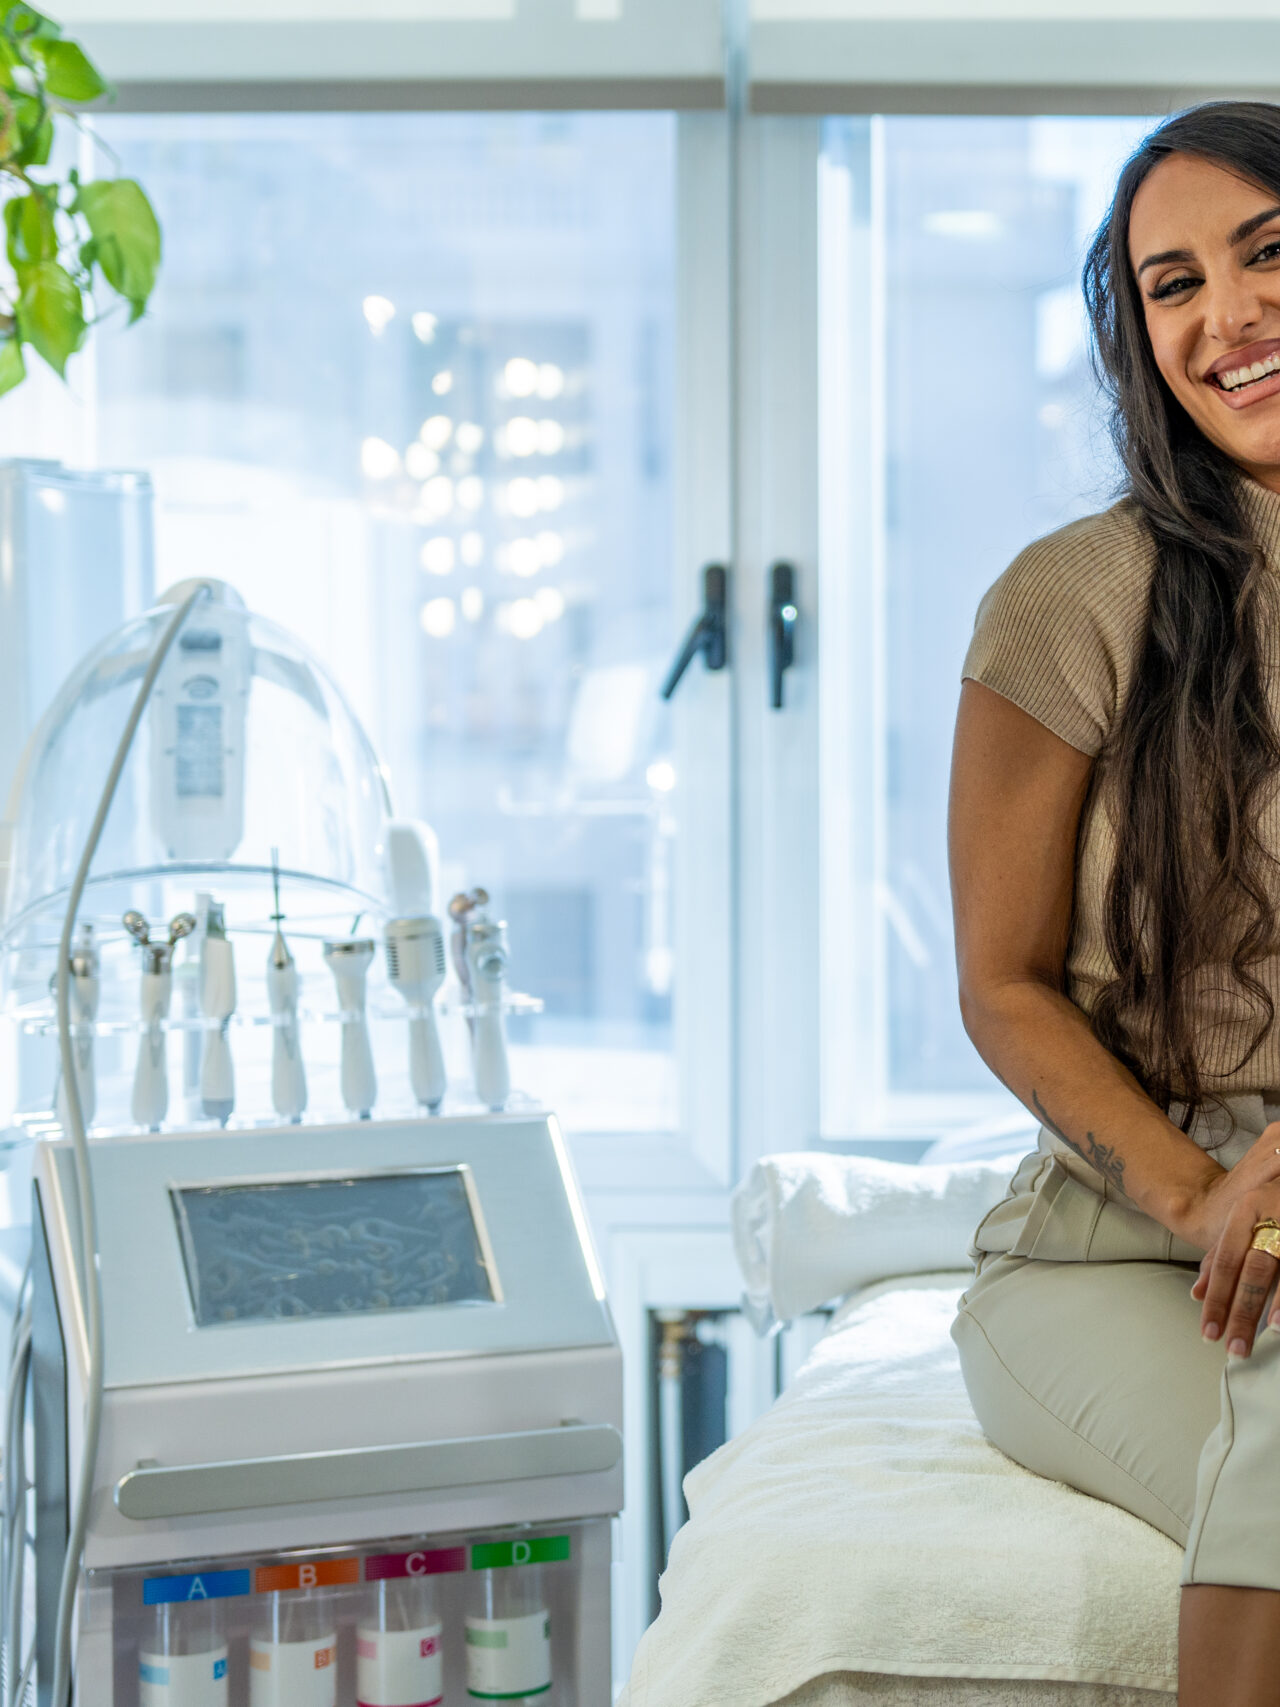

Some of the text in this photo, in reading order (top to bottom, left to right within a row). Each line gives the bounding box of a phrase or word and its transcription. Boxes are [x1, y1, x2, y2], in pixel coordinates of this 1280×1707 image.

[405, 1552, 427, 1577] C
[512, 1541, 531, 1565] D
[188, 1576, 208, 1600] A
[299, 1564, 317, 1588] B
